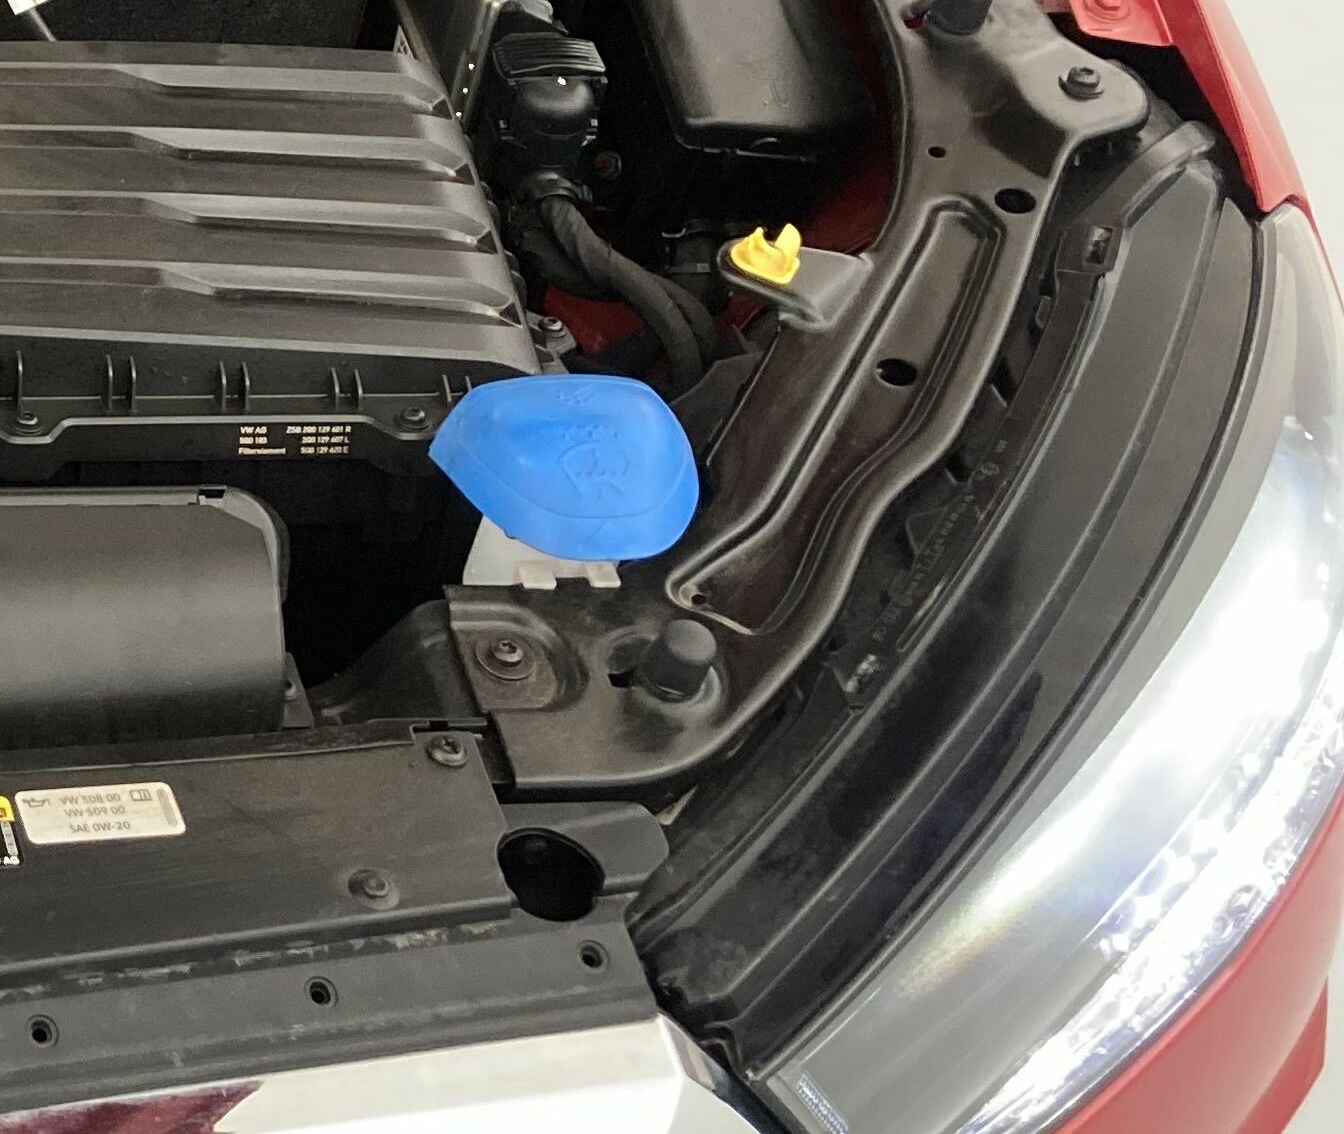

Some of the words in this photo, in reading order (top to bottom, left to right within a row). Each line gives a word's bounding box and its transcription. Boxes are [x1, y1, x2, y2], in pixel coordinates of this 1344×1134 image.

[240, 426, 254, 434] VW
[255, 426, 267, 434] AG
[59, 795, 78, 804] VW
[82, 793, 103, 804] 508
[106, 792, 120, 801] 00
[64, 808, 83, 818] VW
[87, 807, 108, 817] 509
[111, 805, 125, 814] 00
[70, 823, 89, 833] SAE
[93, 821, 130, 831] 0W-20
[3, 855, 20, 866] AG
